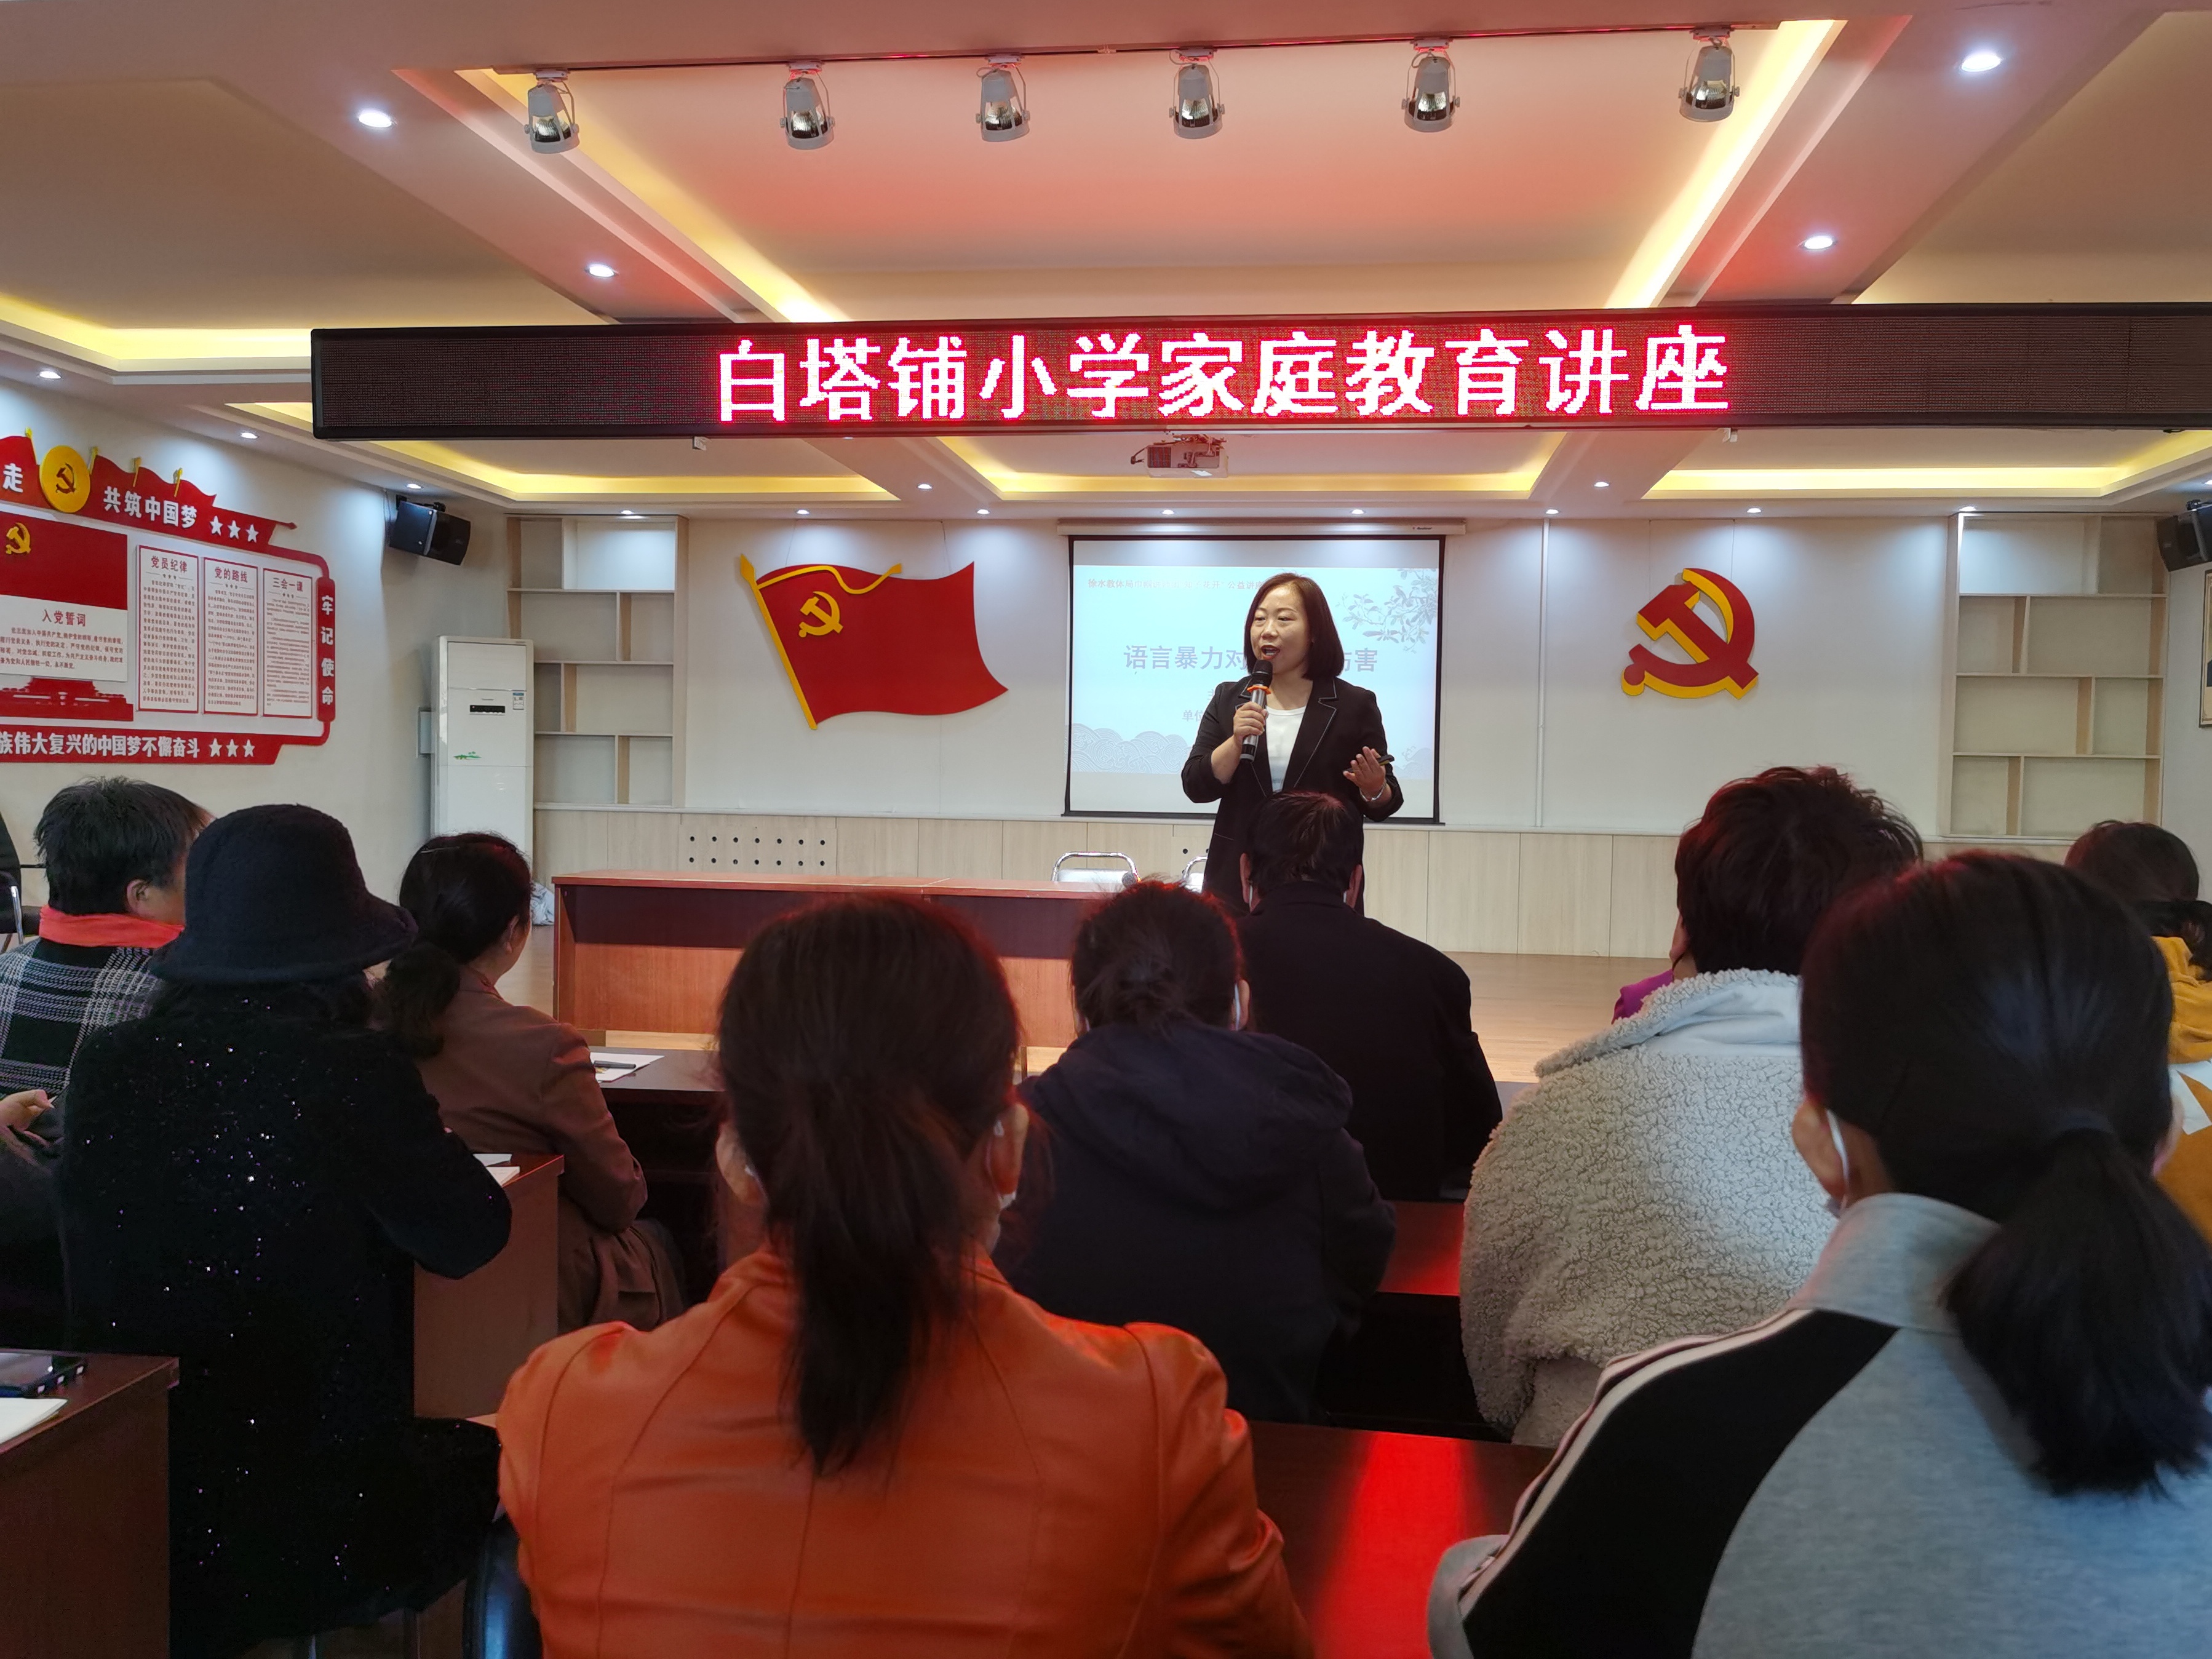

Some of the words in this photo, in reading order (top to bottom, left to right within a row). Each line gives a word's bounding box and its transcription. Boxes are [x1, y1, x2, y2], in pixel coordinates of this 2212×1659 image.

[719, 324, 1730, 423] 白塔铺小学家庭教育讲座
[2, 463, 23, 493] 走
[103, 485, 197, 528] 共筑中国梦
[151, 555, 188, 573] 党员纪律
[215, 566, 248, 583] 党的路线
[42, 609, 86, 627] 入党誓词
[320, 594, 334, 706] 牢记使命
[0, 731, 200, 758] 族伟大复兴的中国梦不懈奋斗
